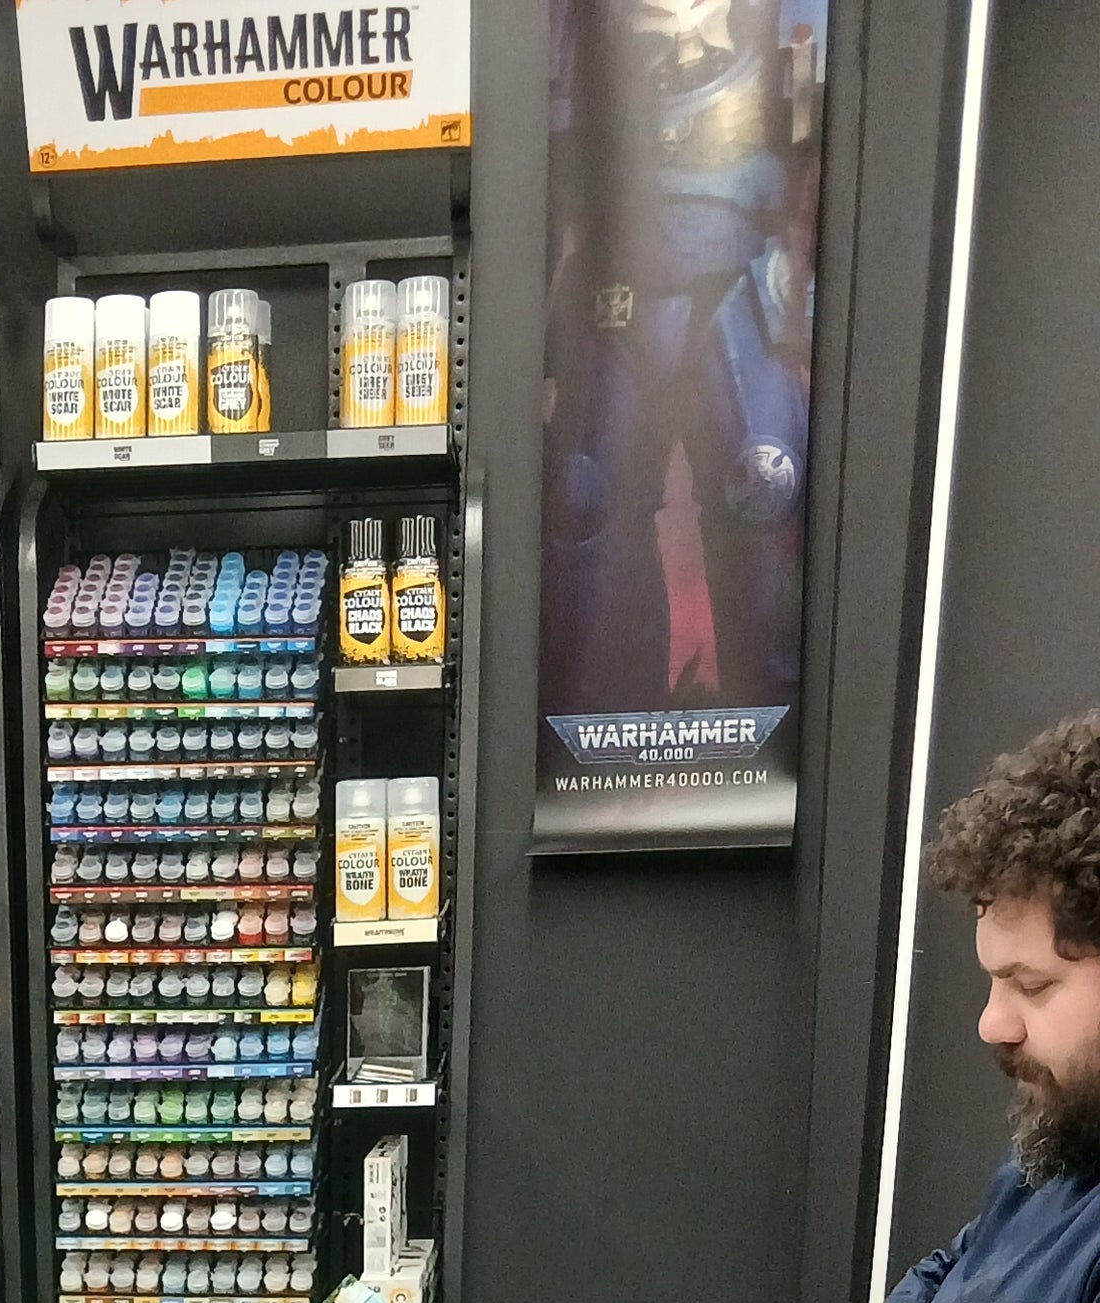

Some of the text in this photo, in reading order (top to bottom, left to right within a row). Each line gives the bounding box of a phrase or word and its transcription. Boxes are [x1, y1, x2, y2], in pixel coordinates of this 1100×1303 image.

[69, 7, 412, 122] WARHAMMER
[283, 73, 408, 104] COLOUR
[578, 719, 757, 749] WARHAMMER
[555, 770, 768, 792] WARHAMMER40000.COM
[339, 858, 380, 870] COLOUR
[391, 855, 433, 867] COLOUR
[345, 879, 374, 891] BONE
